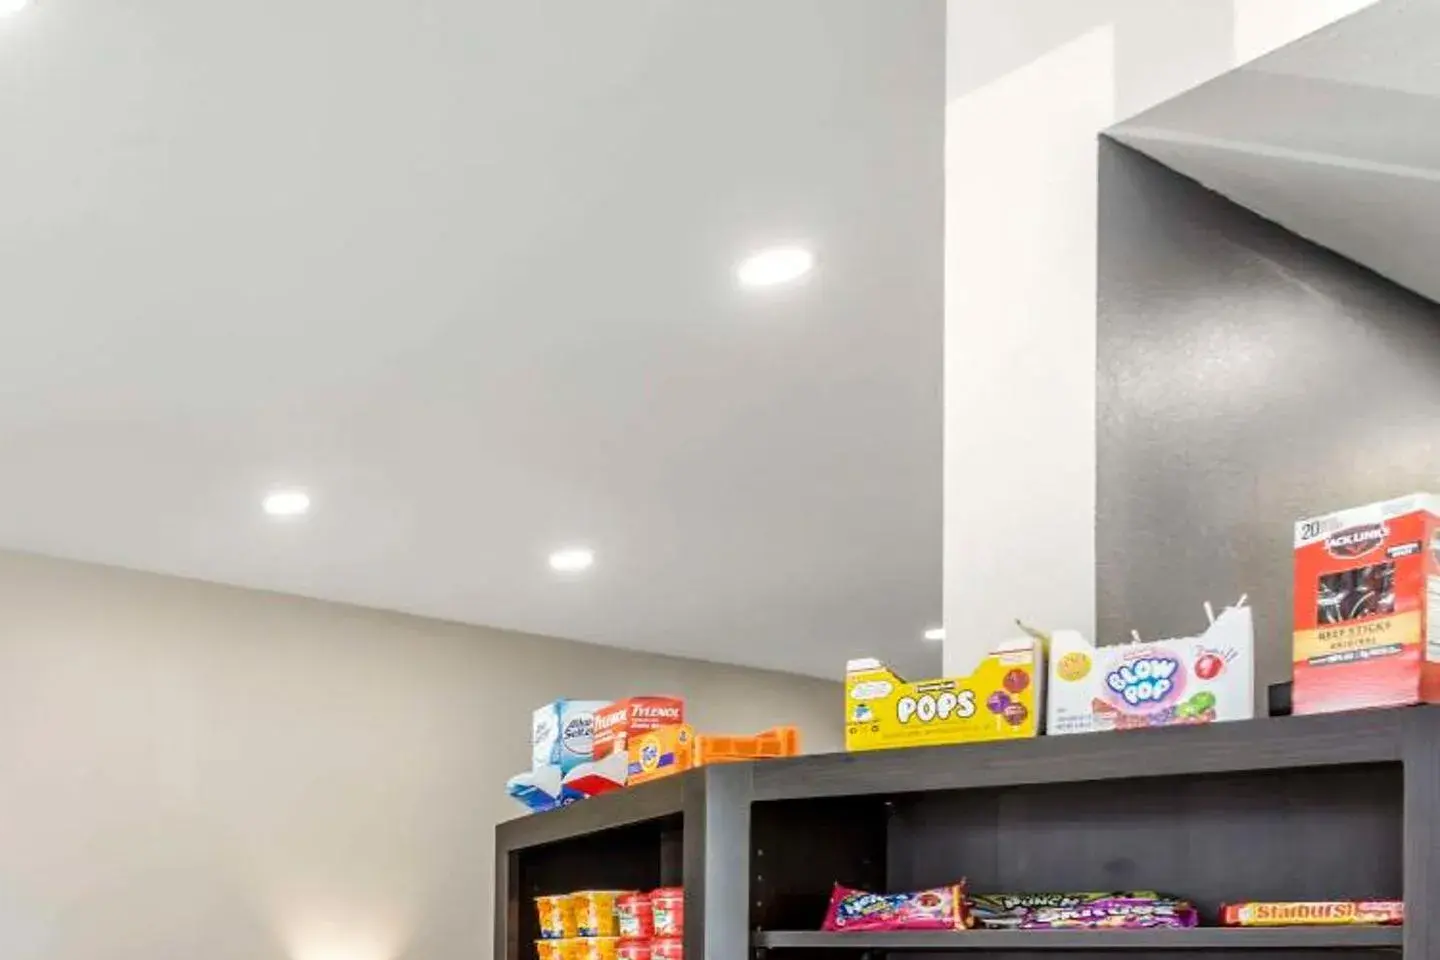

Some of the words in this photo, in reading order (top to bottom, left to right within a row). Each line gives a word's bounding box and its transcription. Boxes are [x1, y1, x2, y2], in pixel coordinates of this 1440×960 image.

[1301, 521, 1320, 541] 20
[1108, 658, 1178, 692] BLOW
[1123, 678, 1172, 706] POP
[631, 703, 680, 719] TYLENOL
[897, 690, 976, 724] POPS
